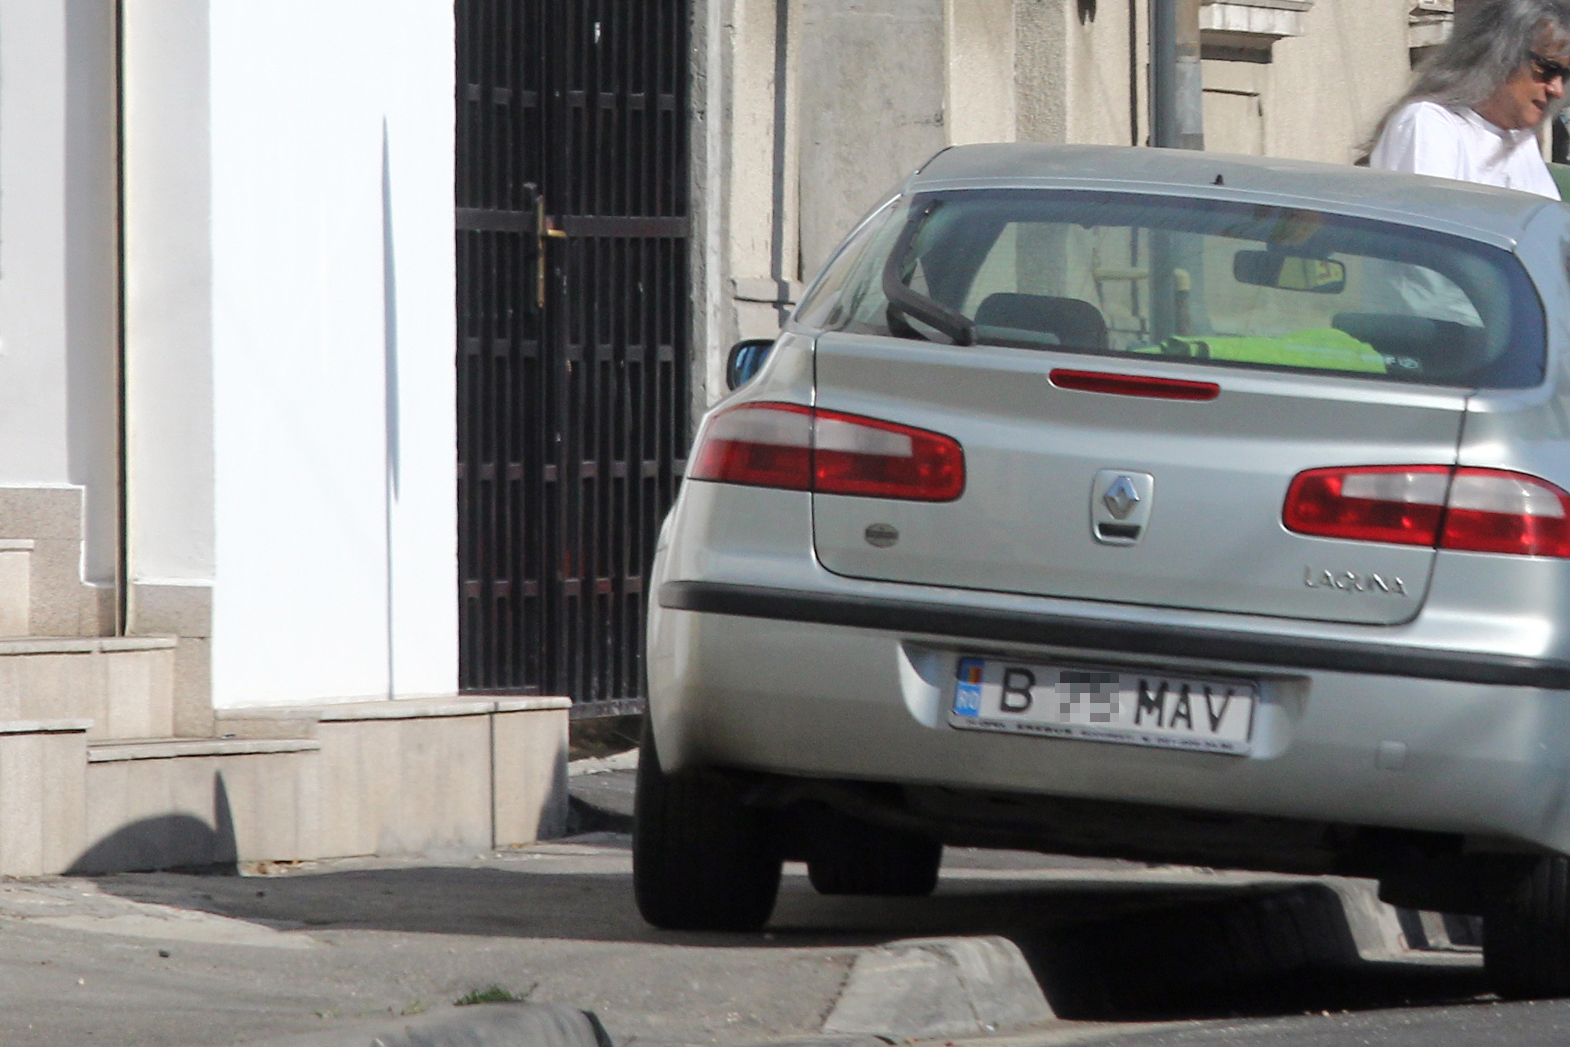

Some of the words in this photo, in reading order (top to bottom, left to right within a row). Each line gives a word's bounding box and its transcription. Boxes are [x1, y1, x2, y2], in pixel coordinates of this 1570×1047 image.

[1304, 565, 1408, 597] LAGUNA
[999, 667, 1037, 714] B
[1134, 678, 1236, 733] MAV
